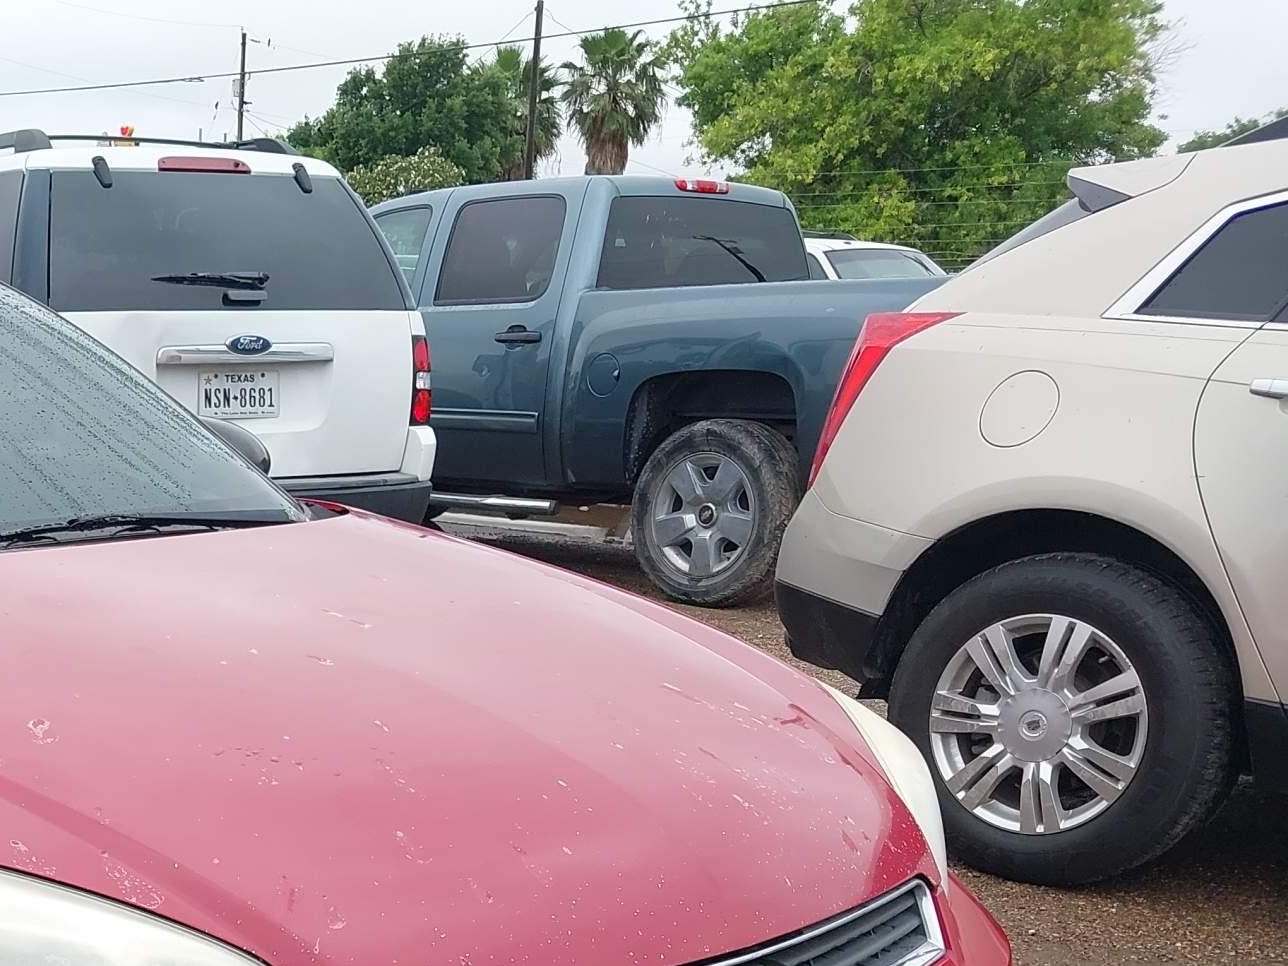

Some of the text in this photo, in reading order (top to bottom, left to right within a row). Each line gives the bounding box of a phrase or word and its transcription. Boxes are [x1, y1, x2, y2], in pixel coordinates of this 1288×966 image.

[237, 337, 263, 350] Ford
[224, 374, 255, 383] TEXAS
[204, 387, 275, 409] NSN 8681
